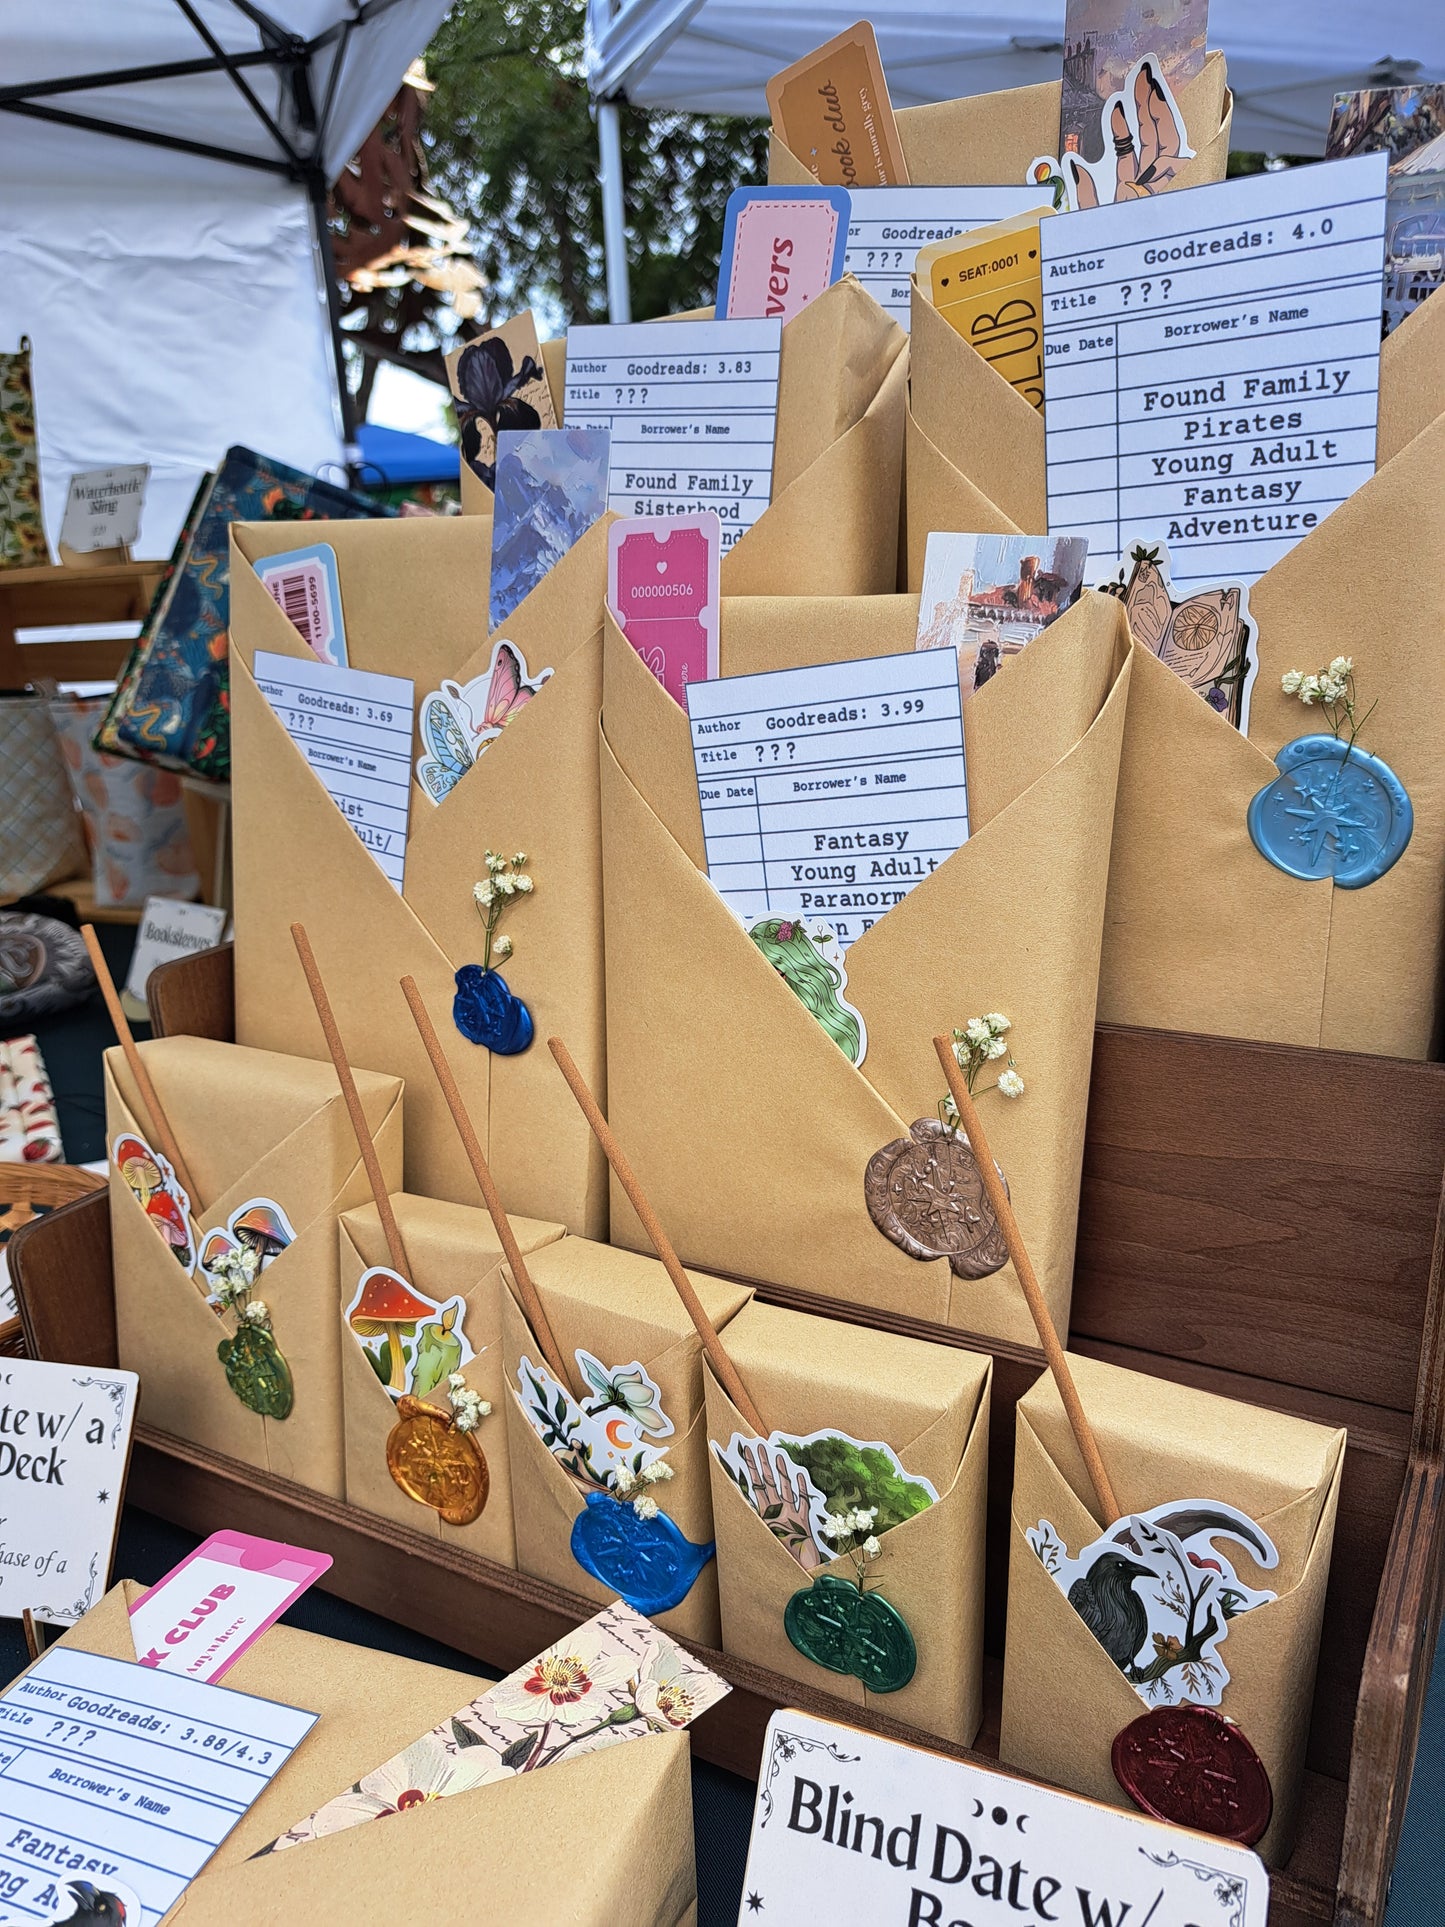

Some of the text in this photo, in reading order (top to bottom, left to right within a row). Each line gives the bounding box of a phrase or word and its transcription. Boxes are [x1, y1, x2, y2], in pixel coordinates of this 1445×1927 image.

[818, 79, 846, 133] club
[859, 87, 872, 112] grey
[863, 113, 882, 160] morally
[1050, 218, 1334, 278] Author Goodreads: 4.0
[959, 253, 1020, 282] SEAT:0001
[1051, 278, 1173, 312] Title ???
[1164, 306, 1309, 338] Borrower's Name
[1045, 335, 1114, 357] Due Date
[570, 361, 752, 376] Author Goodreads: 3.83
[570, 388, 649, 404] Title ???
[1144, 368, 1351, 412] Found Family
[641, 424, 730, 435] Borrower's Name
[1184, 411, 1303, 441] Pirates
[1152, 439, 1338, 476] Young Adult
[625, 473, 753, 496] Found Family
[1184, 479, 1303, 507] Fantasy
[1167, 512, 1318, 540] Adventure
[631, 584, 694, 600] 000000506
[298, 693, 360, 716] Goodreads:
[367, 707, 393, 723] 3.69
[697, 699, 925, 735] Author Goodreads: 3.99
[308, 748, 377, 772] Borrower's Name
[701, 741, 796, 763] Title ???
[700, 785, 754, 800] Due Date
[793, 772, 907, 793] Borrower's Name
[814, 830, 909, 851] Fantasy
[791, 856, 939, 883] Young Adult
[37, 1402, 83, 1442] w/
[86, 1418, 104, 1444] a
[34, 1550, 58, 1577] of
[56, 1560, 68, 1574] a
[164, 1583, 236, 1645] CLUB
[186, 1617, 247, 1675] Anywhere
[19, 1682, 272, 1765] Author Goodreads: 3.88/4.3
[46, 1721, 97, 1747] ???
[49, 1768, 171, 1815] Borrower's Name
[787, 1775, 923, 1871] Blind
[929, 1824, 1061, 1921] Date
